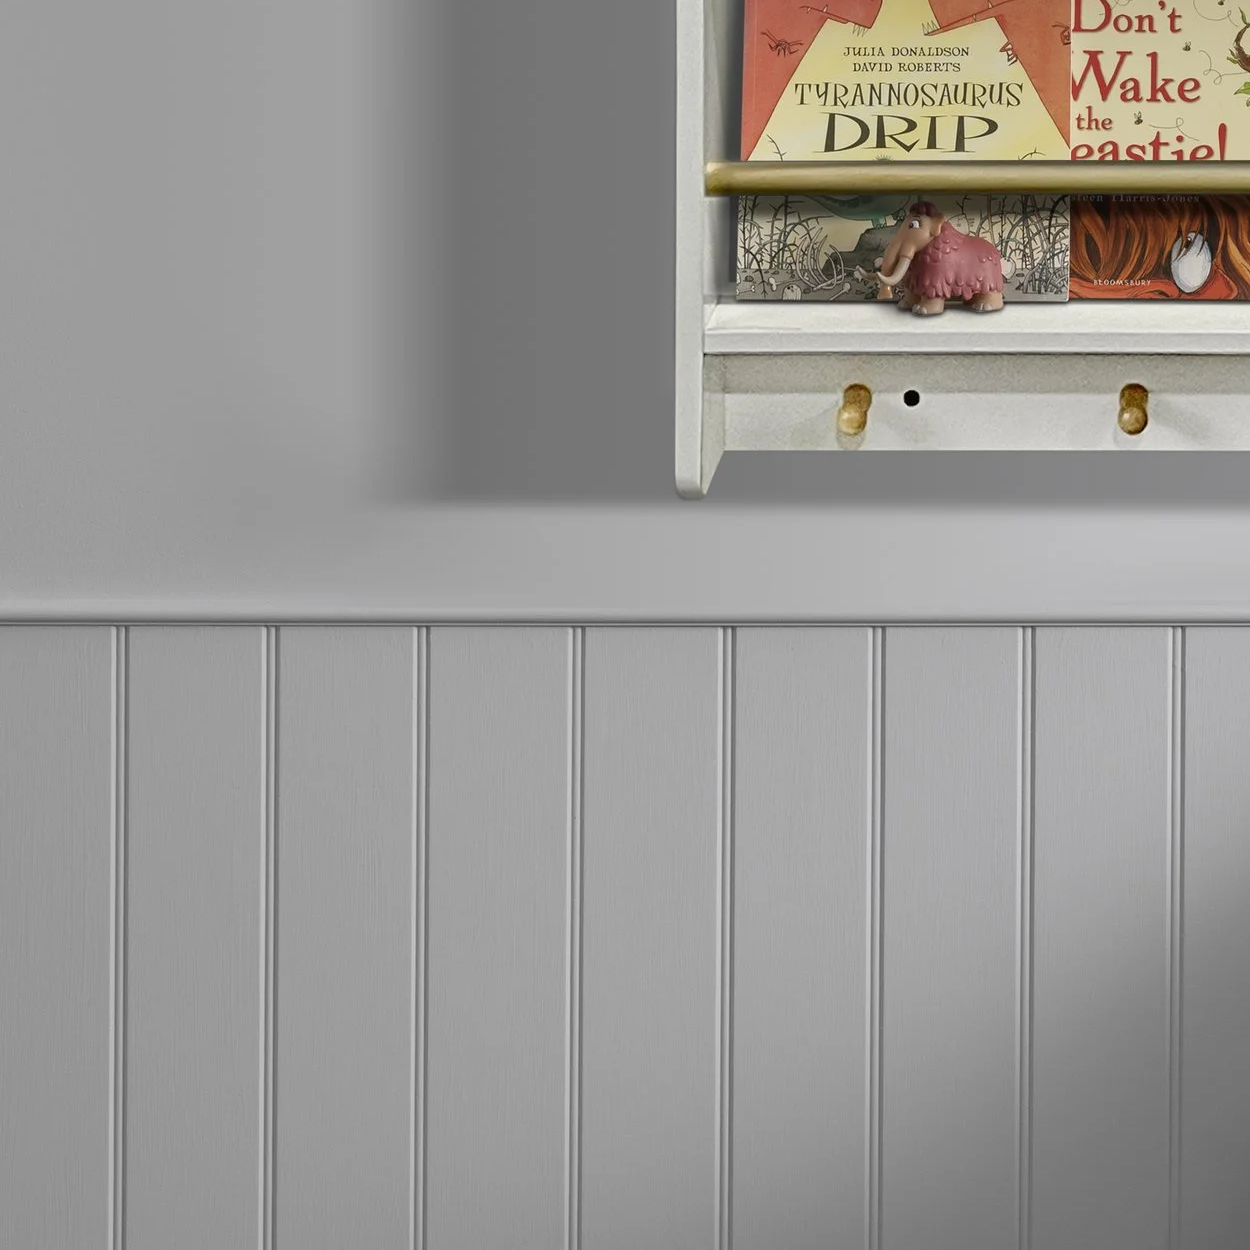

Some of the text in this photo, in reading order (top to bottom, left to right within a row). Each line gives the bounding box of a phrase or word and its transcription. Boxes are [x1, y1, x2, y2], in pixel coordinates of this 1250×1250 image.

[843, 46, 970, 58] JULIA DONALDSON
[852, 62, 961, 73] DAVID ROBERTS
[1071, 50, 1201, 103] Wake
[794, 81, 1024, 109] TYRANNOSAURUS
[1075, 105, 1113, 131] the
[812, 112, 999, 153] DRIP
[1070, 122, 1228, 161] eastie!
